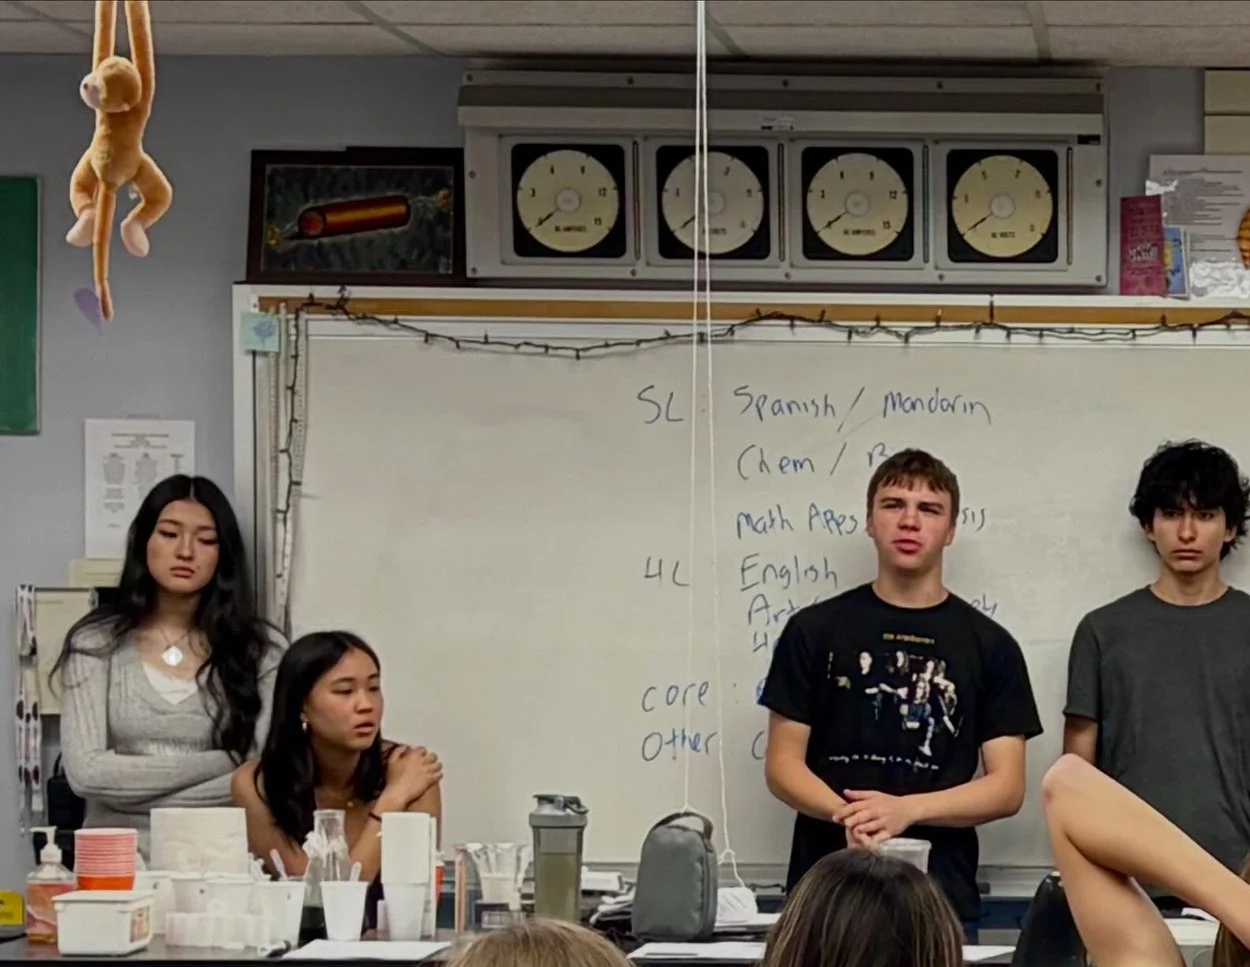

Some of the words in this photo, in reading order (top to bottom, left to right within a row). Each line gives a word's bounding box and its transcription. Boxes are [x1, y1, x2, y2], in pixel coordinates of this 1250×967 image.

[637, 385, 684, 424] SL
[733, 385, 836, 422] Spanish
[883, 387, 992, 425] Mandarin
[737, 444, 815, 480] Chem
[740, 553, 838, 592] English
